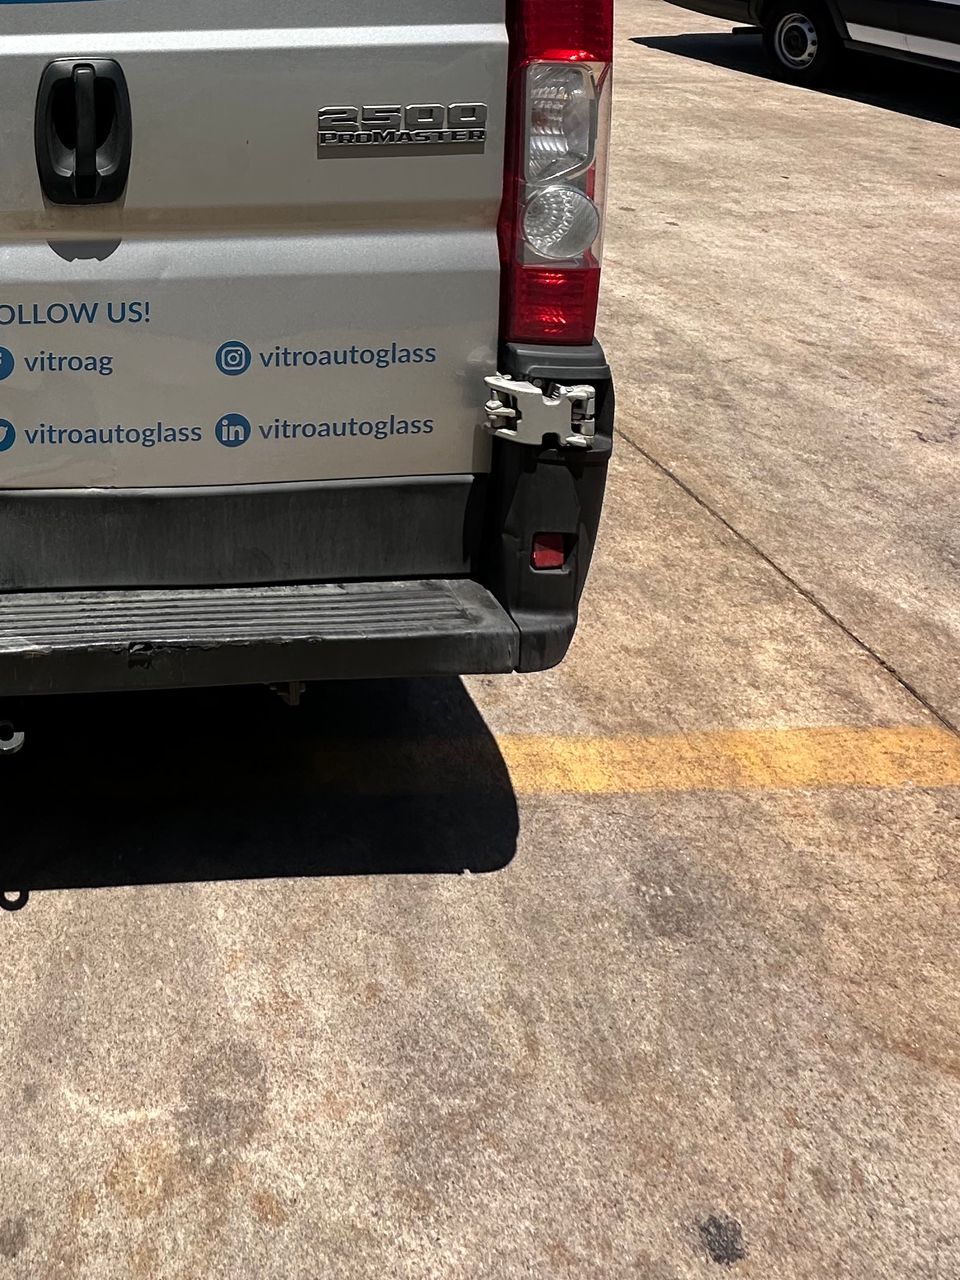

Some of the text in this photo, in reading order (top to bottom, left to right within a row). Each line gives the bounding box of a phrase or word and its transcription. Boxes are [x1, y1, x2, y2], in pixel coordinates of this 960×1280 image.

[318, 102, 487, 132] 2500
[107, 301, 151, 323] US!
[24, 350, 113, 377] vitroag
[259, 345, 436, 371] vitroautoglass
[25, 422, 202, 449] vitroautoglass
[258, 415, 433, 442] vitroautoglass
